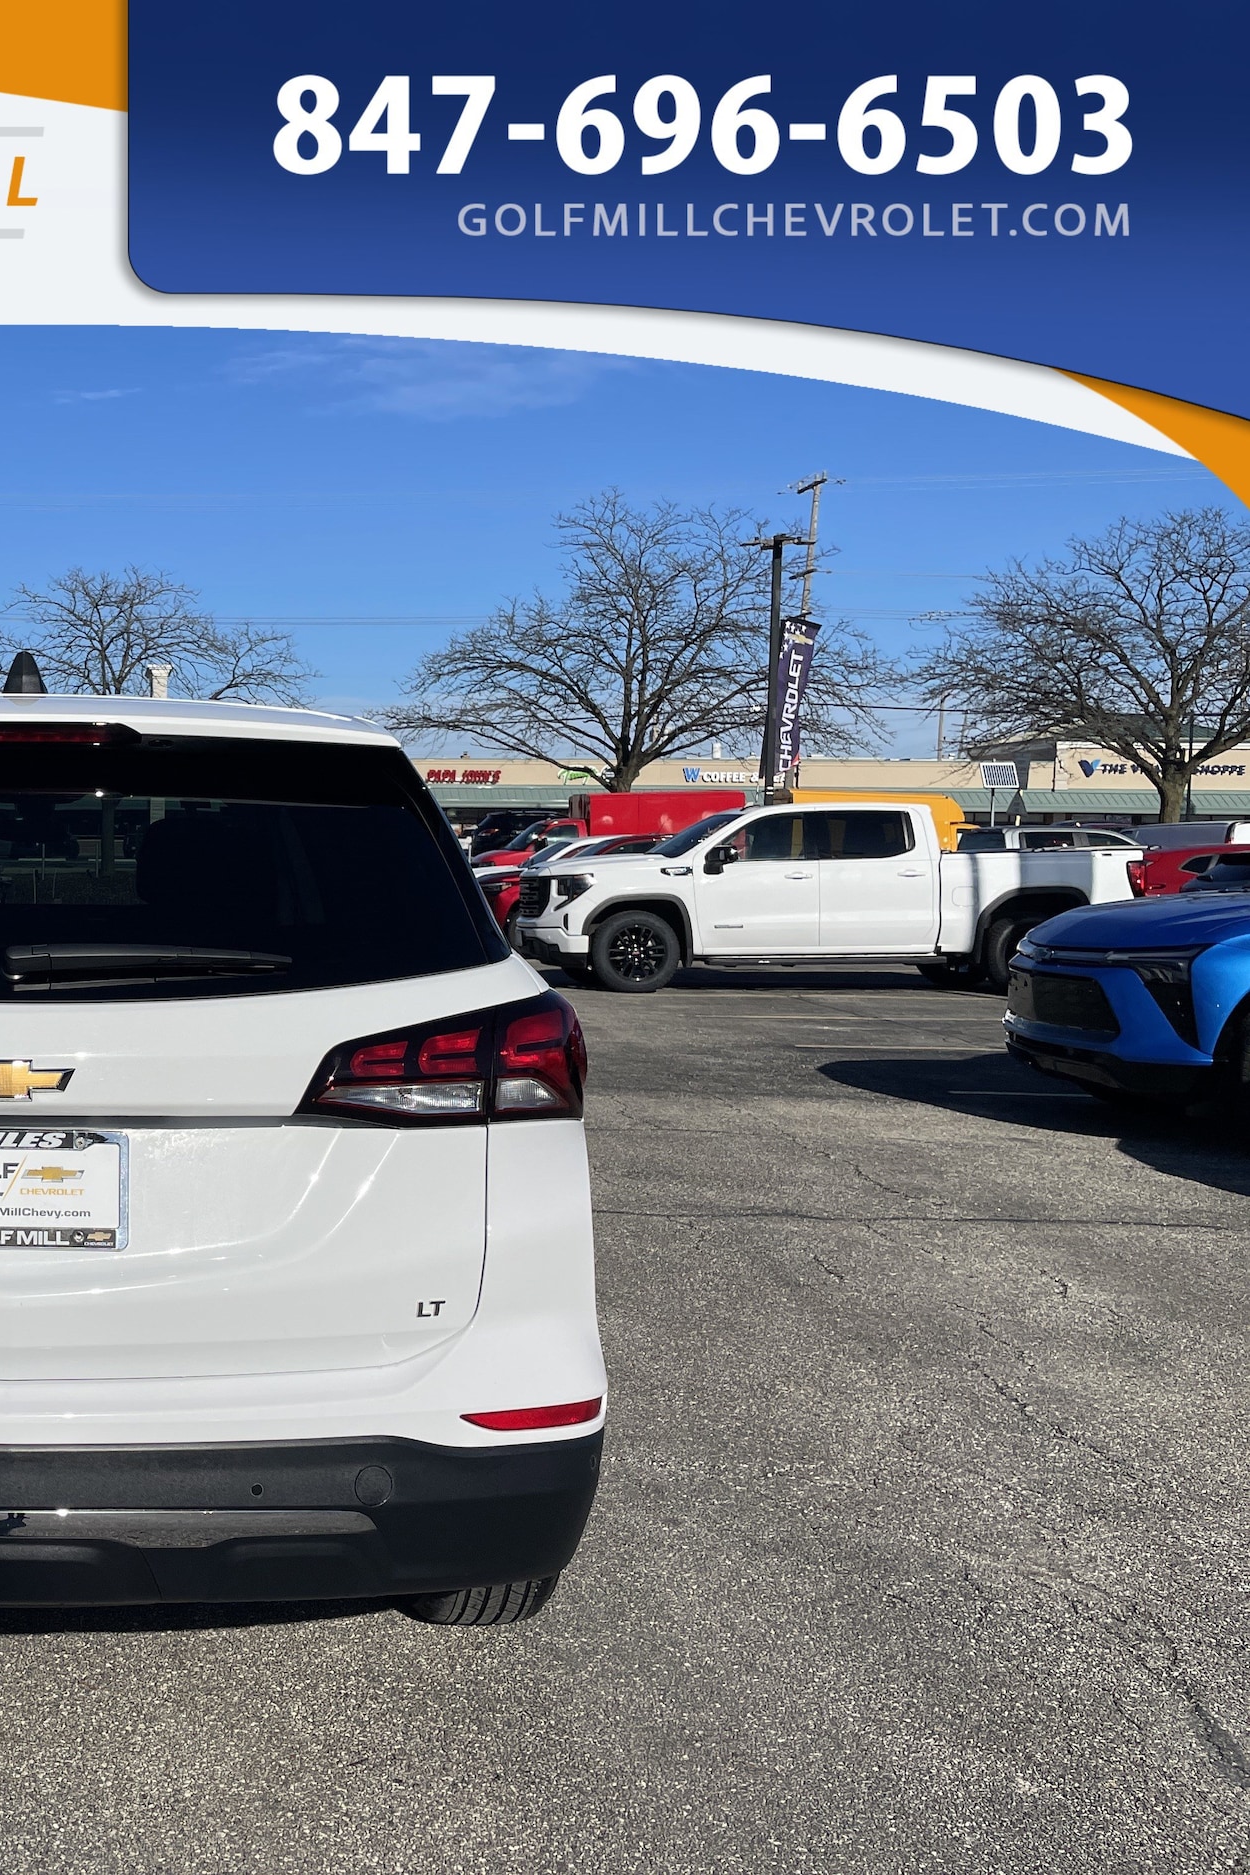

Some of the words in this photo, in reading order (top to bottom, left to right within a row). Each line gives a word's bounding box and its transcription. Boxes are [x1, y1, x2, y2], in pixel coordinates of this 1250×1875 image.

[779, 650, 804, 773] CHEVROLET
[427, 769, 457, 784] PAPA
[460, 769, 502, 785] JOHN'S
[702, 771, 747, 783] COFFEE
[1100, 763, 1128, 775] THE
[19, 1187, 86, 1197] CHEVROLET
[16, 1230, 71, 1247] MILL
[416, 1300, 446, 1318] LT
